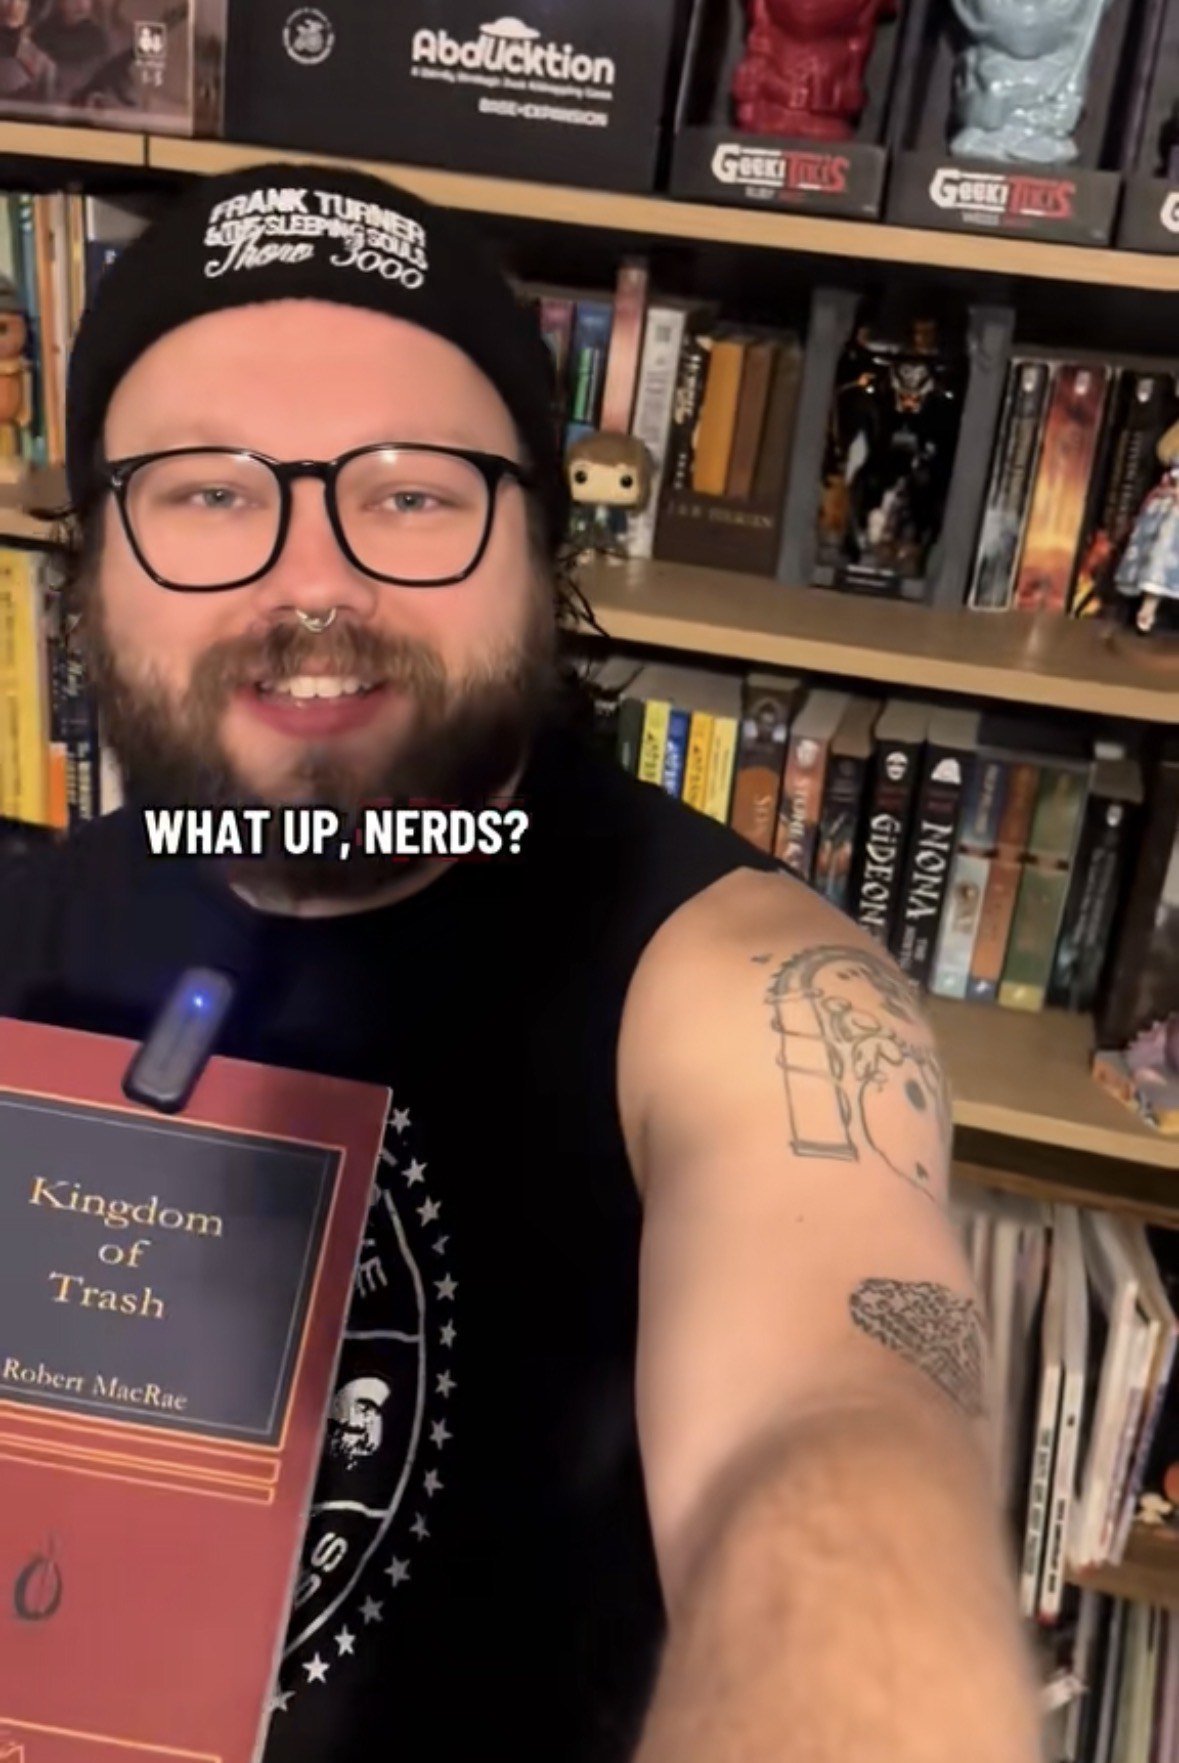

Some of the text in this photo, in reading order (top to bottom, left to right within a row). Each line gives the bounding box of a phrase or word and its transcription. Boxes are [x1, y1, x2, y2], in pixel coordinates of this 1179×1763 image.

[208, 188, 427, 247] FRANK TURNER
[264, 214, 365, 241] SLEEPING
[366, 228, 429, 271] SOULS
[329, 235, 425, 290] 3000
[905, 820, 954, 921] NONA
[28, 1175, 224, 1237] Kingdom
[98, 1239, 152, 1269] of
[48, 1270, 166, 1320] Trash
[1, 1356, 189, 1412] Robert MacRae
